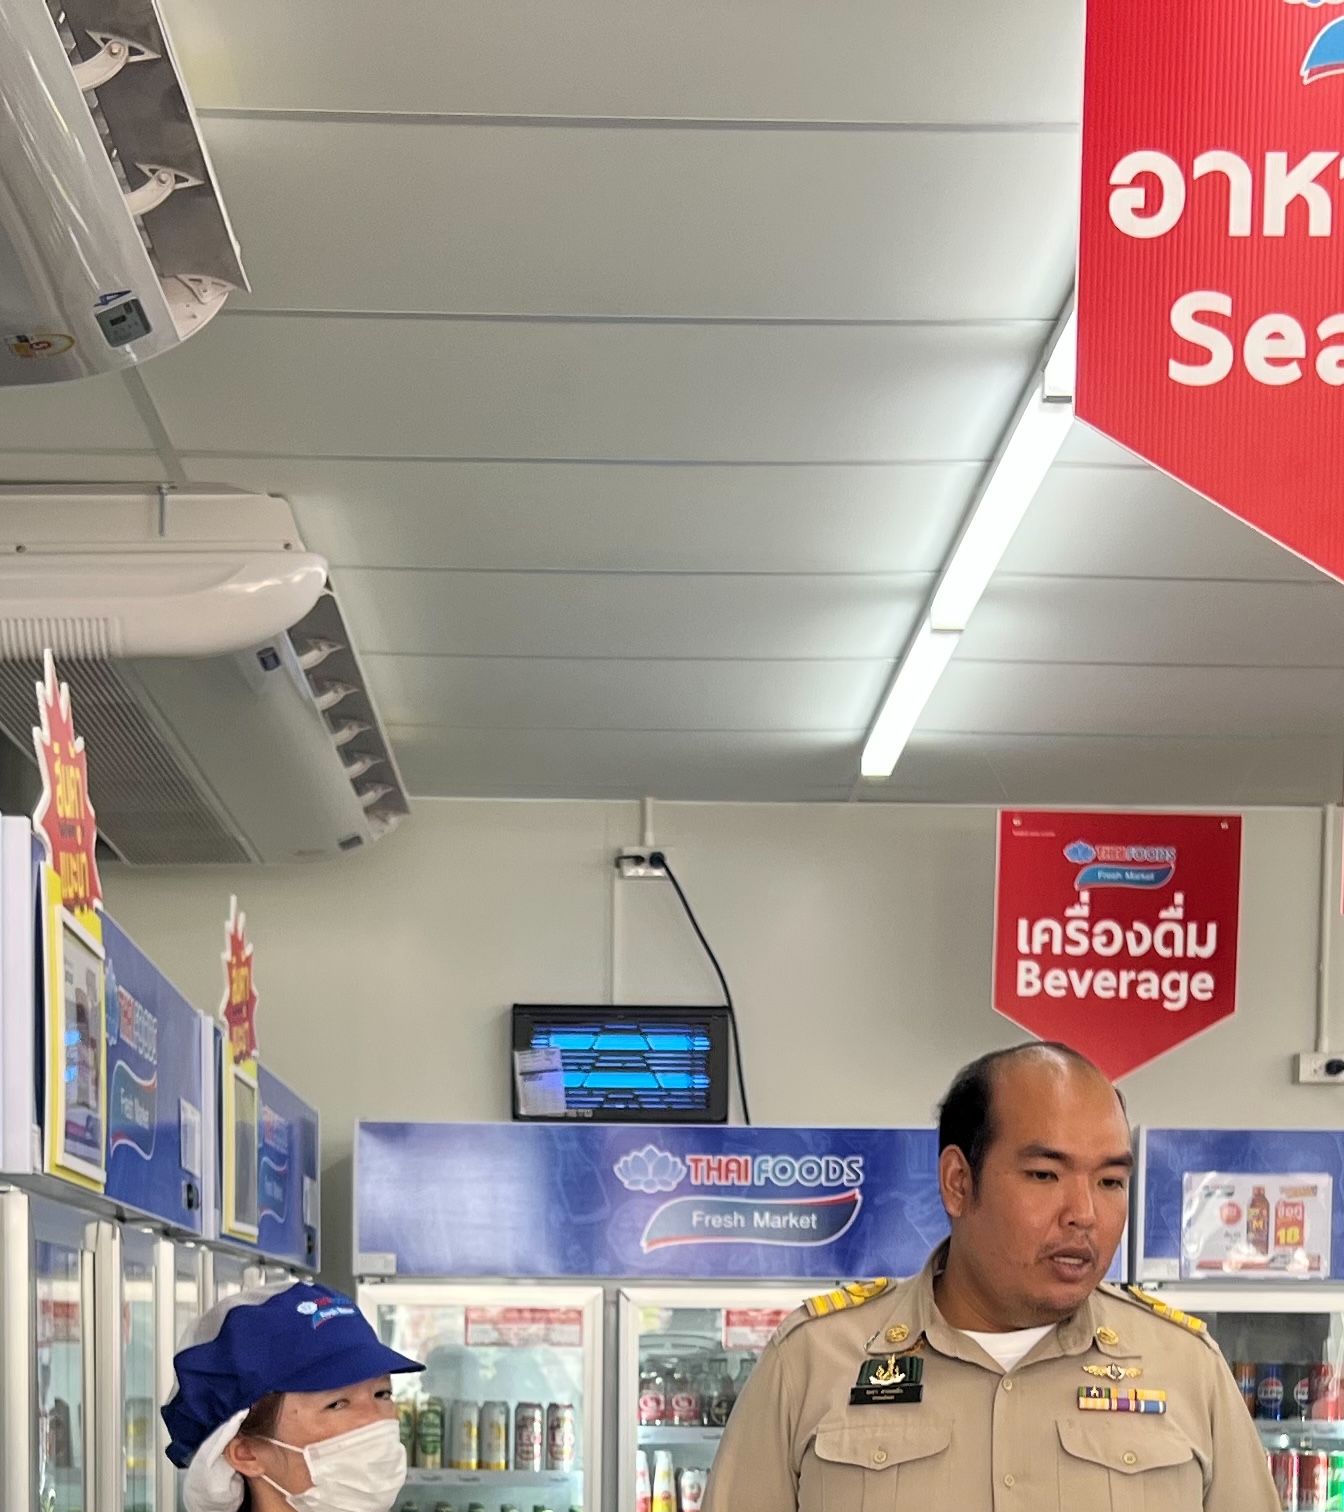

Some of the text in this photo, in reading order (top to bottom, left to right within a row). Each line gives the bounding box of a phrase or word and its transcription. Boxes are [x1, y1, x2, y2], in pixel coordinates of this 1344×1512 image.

[1017, 891, 1217, 959] เครื่องดื่ม
[1016, 960, 1216, 1012] Beverage
[687, 1155, 864, 1187] THAI FOODS
[691, 1211, 818, 1232] Fresh Market
